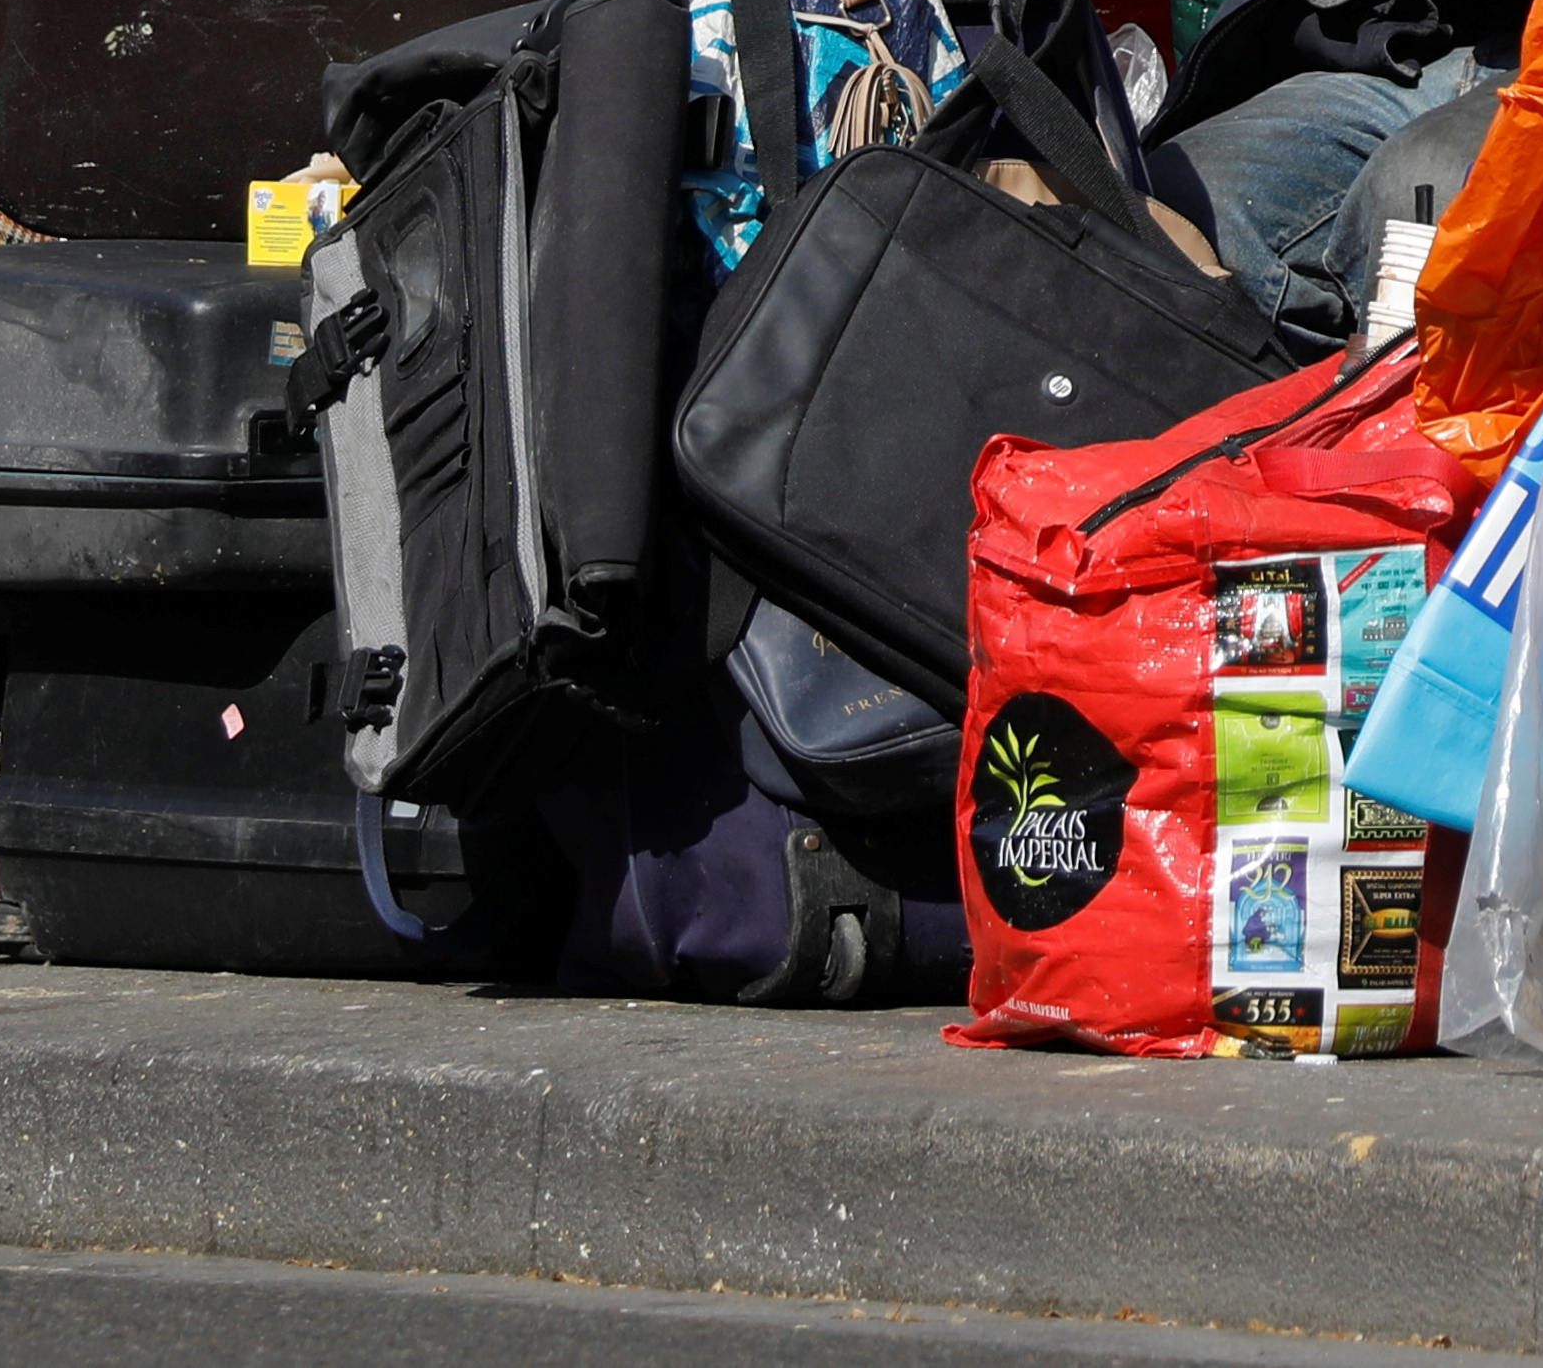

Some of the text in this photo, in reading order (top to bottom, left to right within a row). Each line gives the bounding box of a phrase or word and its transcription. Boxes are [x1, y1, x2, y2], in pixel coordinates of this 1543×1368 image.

[1050, 375, 1071, 397] hp
[1016, 810, 1088, 840] PALAIS
[998, 837, 1105, 873] IMPERIAL
[1372, 891, 1417, 901] SUPER EXTRA
[1029, 999, 1072, 1021] IMPERIAL
[1246, 998, 1292, 1024] 555
